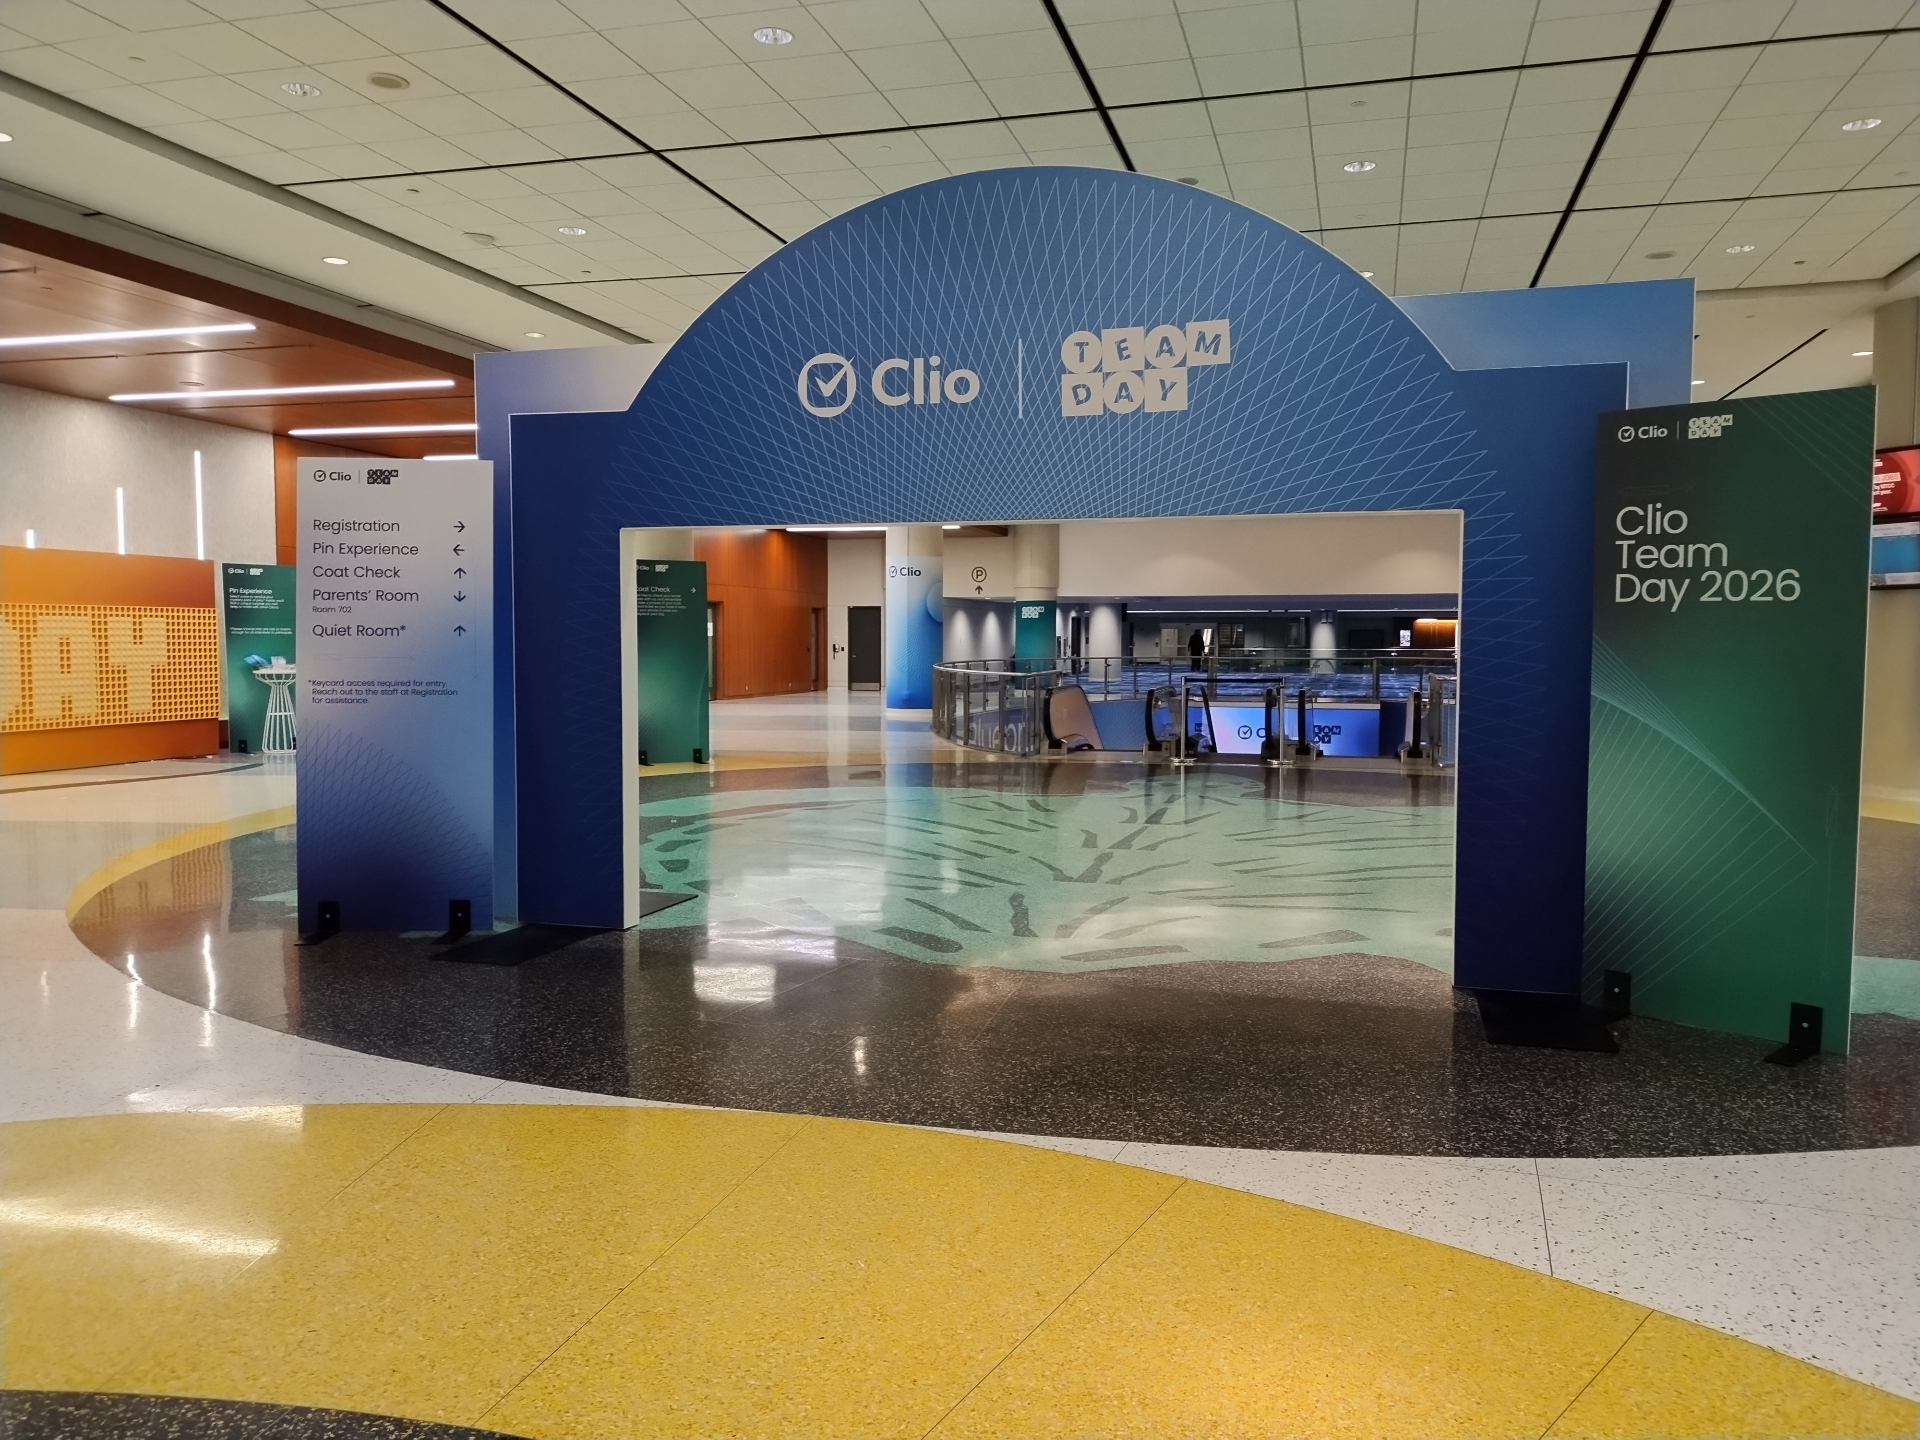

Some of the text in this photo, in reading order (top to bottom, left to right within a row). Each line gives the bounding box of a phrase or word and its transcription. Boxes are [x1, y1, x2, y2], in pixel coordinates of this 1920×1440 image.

[1068, 325, 1226, 367] TEAM
[871, 355, 981, 406] Clio
[1067, 373, 1182, 411] DAY
[1690, 415, 1732, 427] TEAM
[1638, 426, 1668, 439] Clio
[1690, 426, 1721, 438] DAY
[329, 471, 352, 482] Clio
[1616, 502, 1688, 536] Clio
[313, 519, 400, 535] Registration
[313, 542, 419, 558] Pin Experience
[1615, 540, 1728, 569] Team
[313, 566, 400, 578] Coat Check
[900, 566, 922, 577] Clio
[313, 589, 419, 602] Parents’ Room
[1615, 569, 1801, 613] Day 2026
[312, 624, 352, 637] Quiet
[377, 681, 410, 689] required
[425, 681, 447, 689] entry.
[411, 689, 458, 697] Registration
